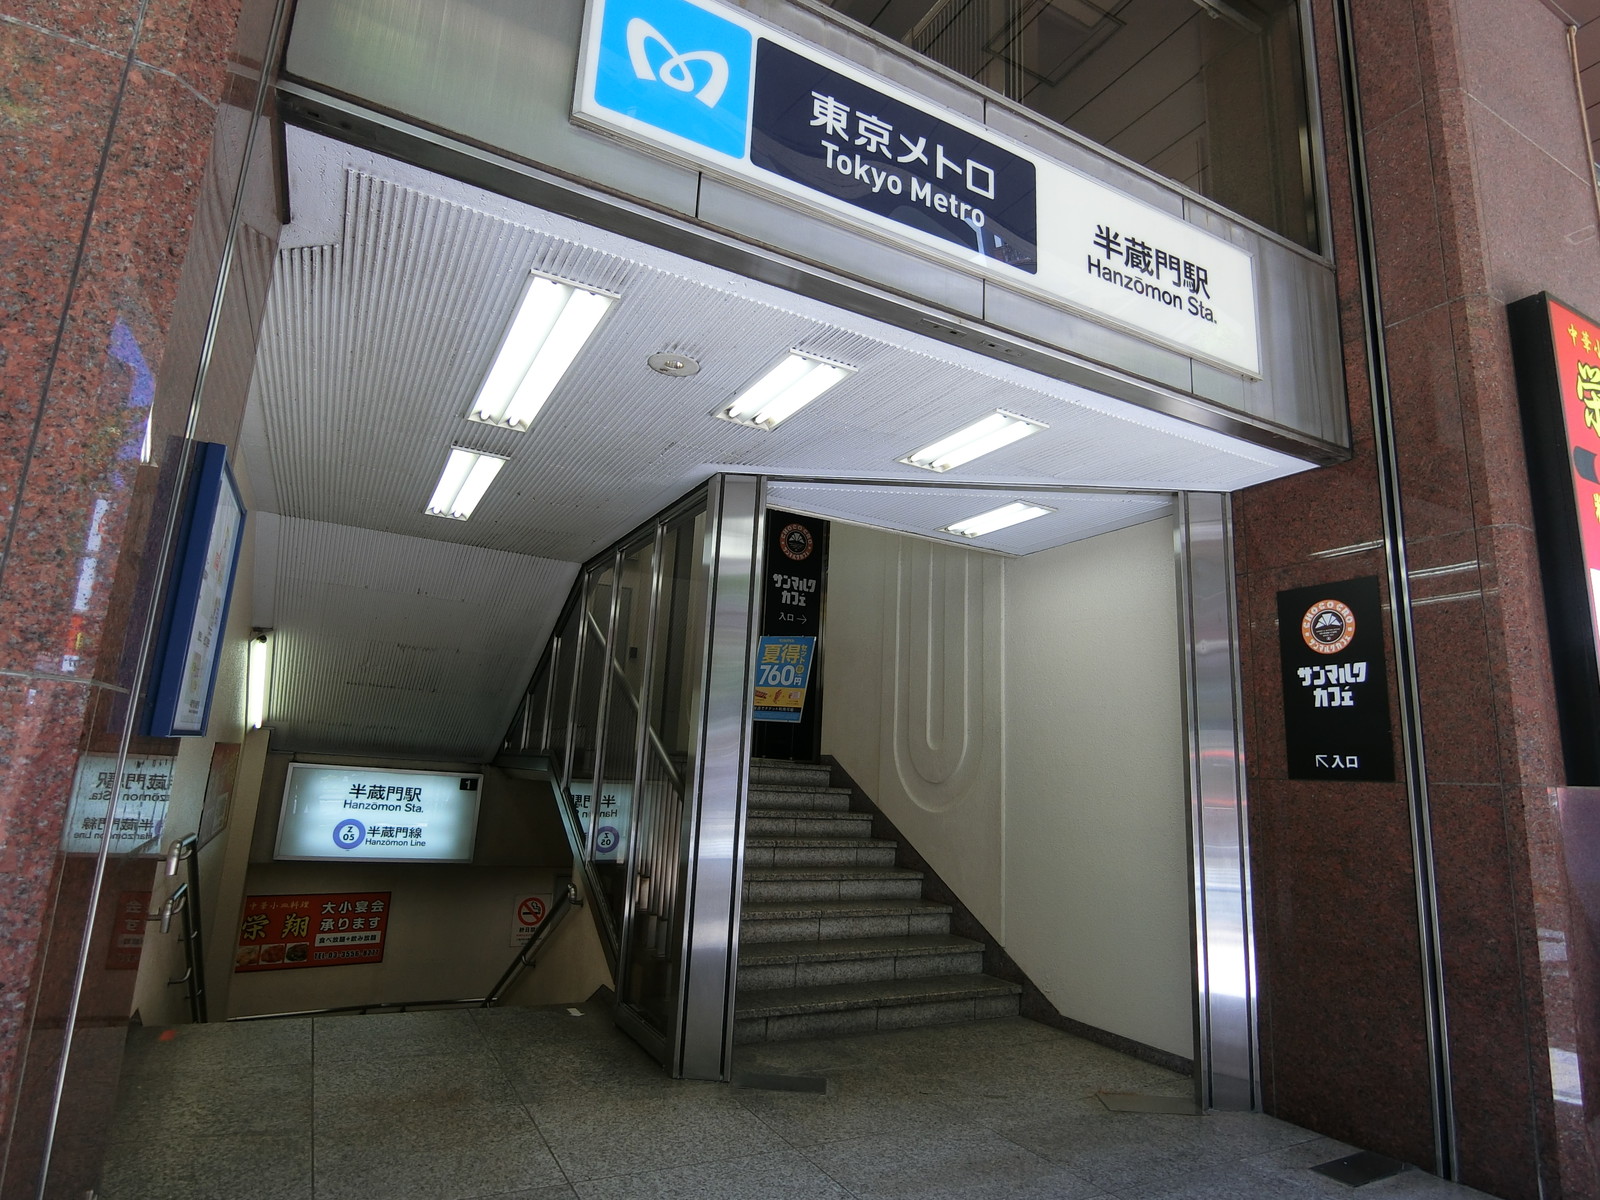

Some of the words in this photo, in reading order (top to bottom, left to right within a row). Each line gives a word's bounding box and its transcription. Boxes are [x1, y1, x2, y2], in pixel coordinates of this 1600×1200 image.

[809, 91, 994, 200] 東京メトロ
[821, 140, 902, 195] Tokyo
[911, 177, 985, 228] Metro
[1093, 224, 1211, 300] 半蔵門駅
[1087, 254, 1183, 310] Hanzōmon
[1188, 296, 1218, 324] Sta.
[773, 573, 816, 593] サンマルク
[781, 590, 806, 607] カフェ
[778, 611, 794, 621] 入口
[1303, 601, 1334, 628] CHOCO
[761, 644, 800, 664] 夏得
[1297, 661, 1367, 687] サンマルク
[1313, 686, 1355, 708] カフェ
[1331, 755, 1358, 768] 入口
[348, 783, 422, 802] 半蔵門駅
[465, 780, 471, 789] 1
[343, 799, 402, 812] Hanzōmon
[404, 803, 424, 813] Sta.
[342, 833, 355, 841] 05
[366, 826, 422, 839] 半蔵門線
[365, 838, 408, 846] Hanzōmon
[410, 839, 426, 847] Line
[321, 899, 385, 915] 大小宴会
[320, 916, 382, 931] 承ります
